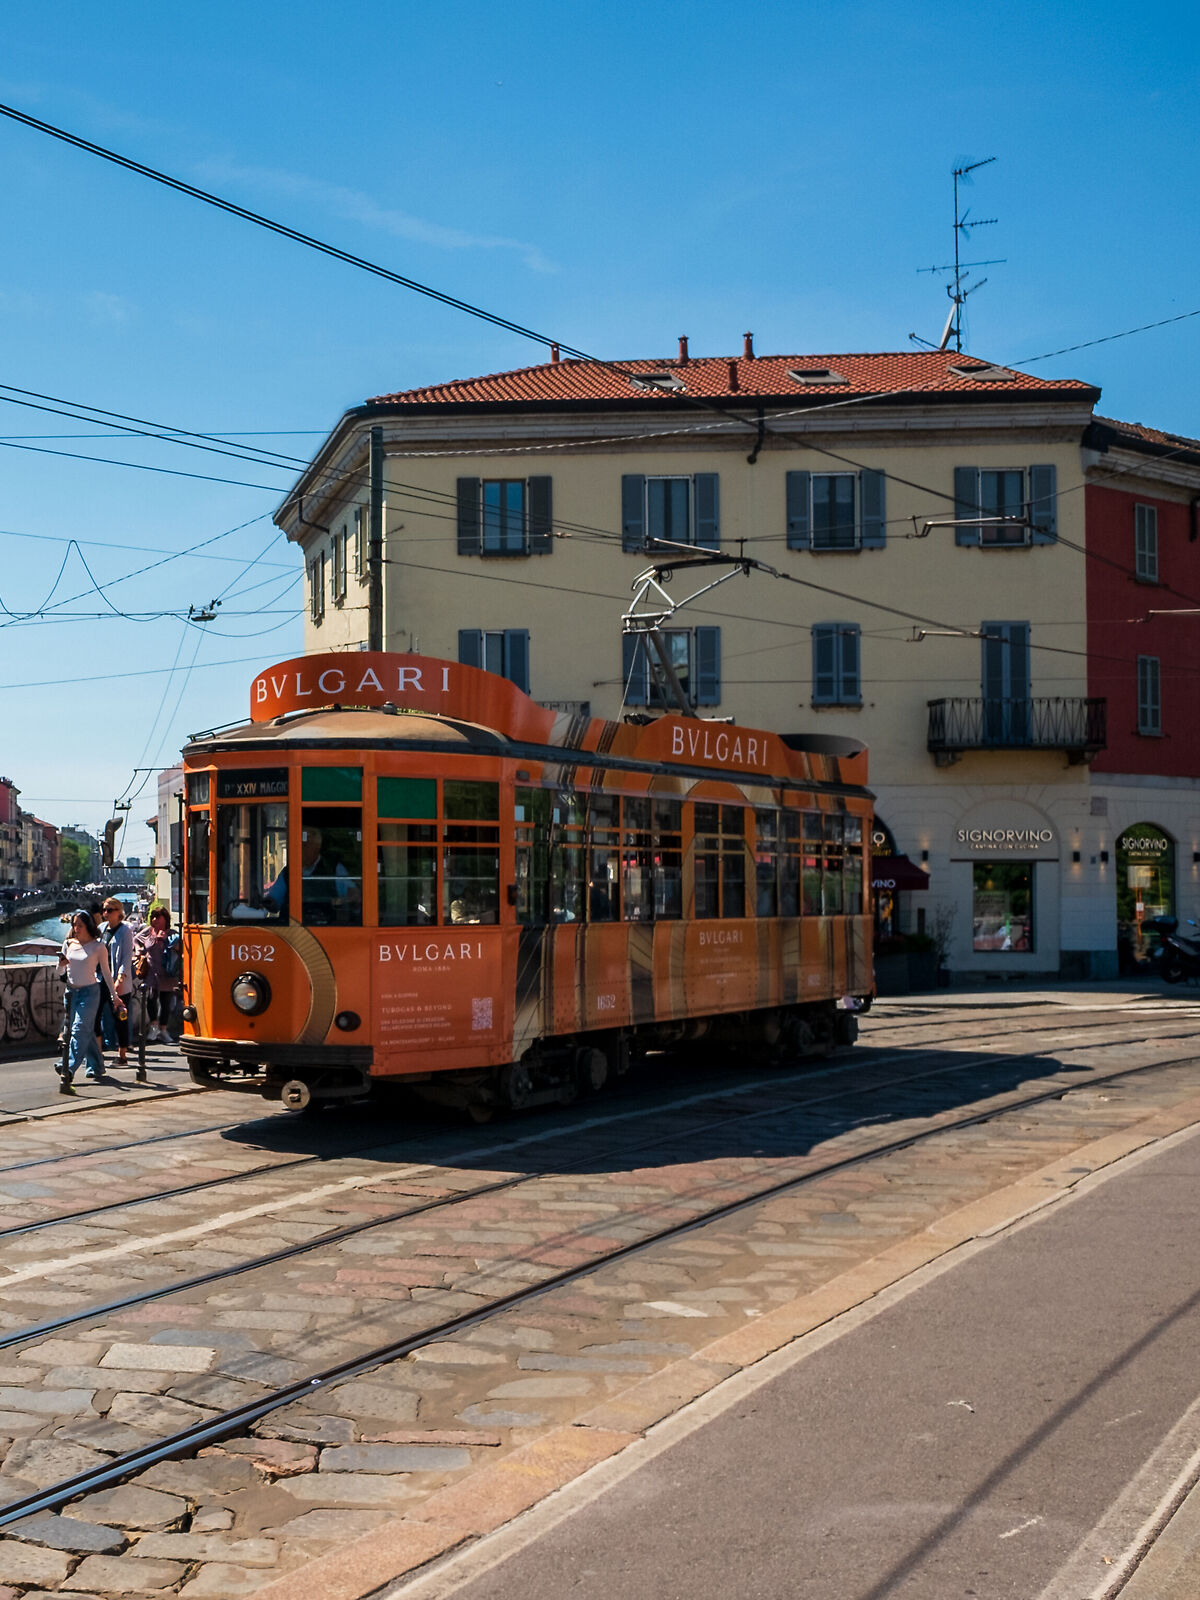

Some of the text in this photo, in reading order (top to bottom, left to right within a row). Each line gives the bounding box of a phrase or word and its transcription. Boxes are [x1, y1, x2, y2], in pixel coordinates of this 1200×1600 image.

[256, 666, 451, 703] BVLGARI
[671, 725, 768, 767] BVLGARI
[236, 782, 257, 795] XXIV
[957, 829, 1054, 842] SIGNORVINO
[1121, 837, 1168, 850] SIGNORVINO
[699, 929, 744, 945] BVLGARI
[230, 944, 275, 962] 1652
[379, 943, 482, 962] BVLGARI
